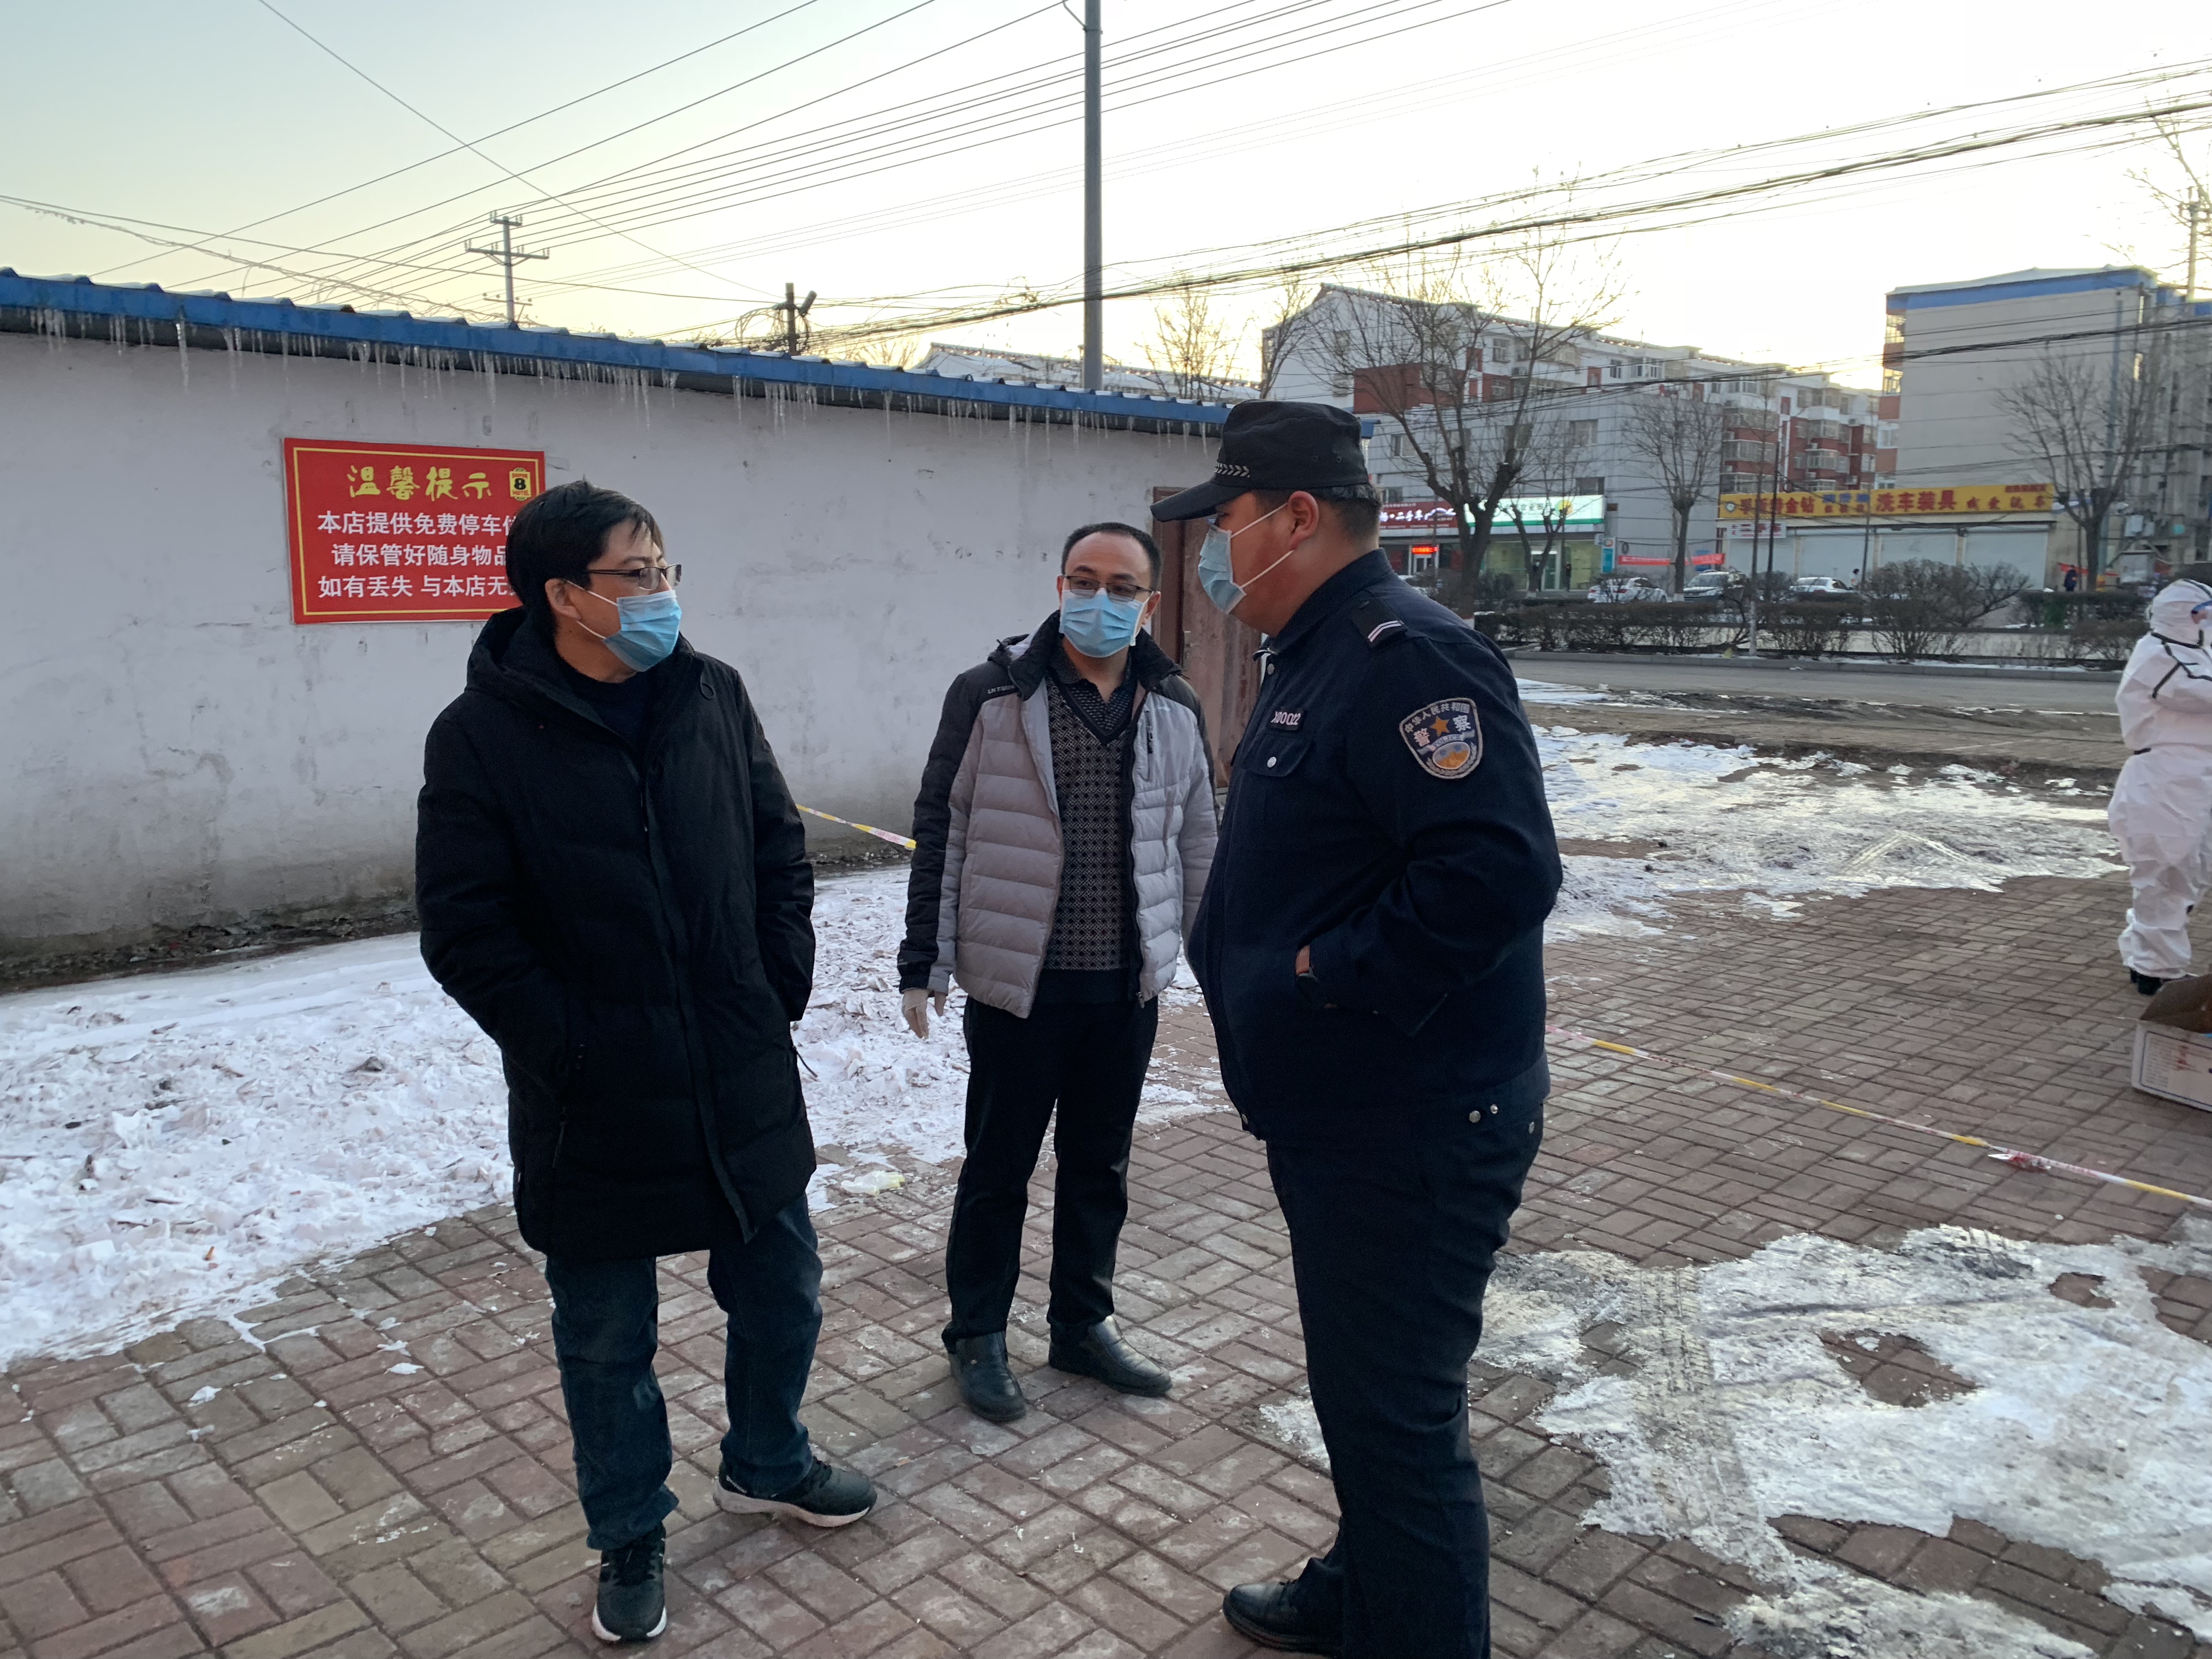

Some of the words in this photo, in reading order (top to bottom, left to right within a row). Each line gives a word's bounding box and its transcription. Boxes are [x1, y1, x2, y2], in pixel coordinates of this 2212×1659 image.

[347, 465, 492, 501] 温馨提示
[514, 477, 527, 490] 8
[318, 575, 413, 598] 如有丢失
[421, 575, 516, 597] 与本店无
[1404, 702, 1470, 733] 中华人民共和国
